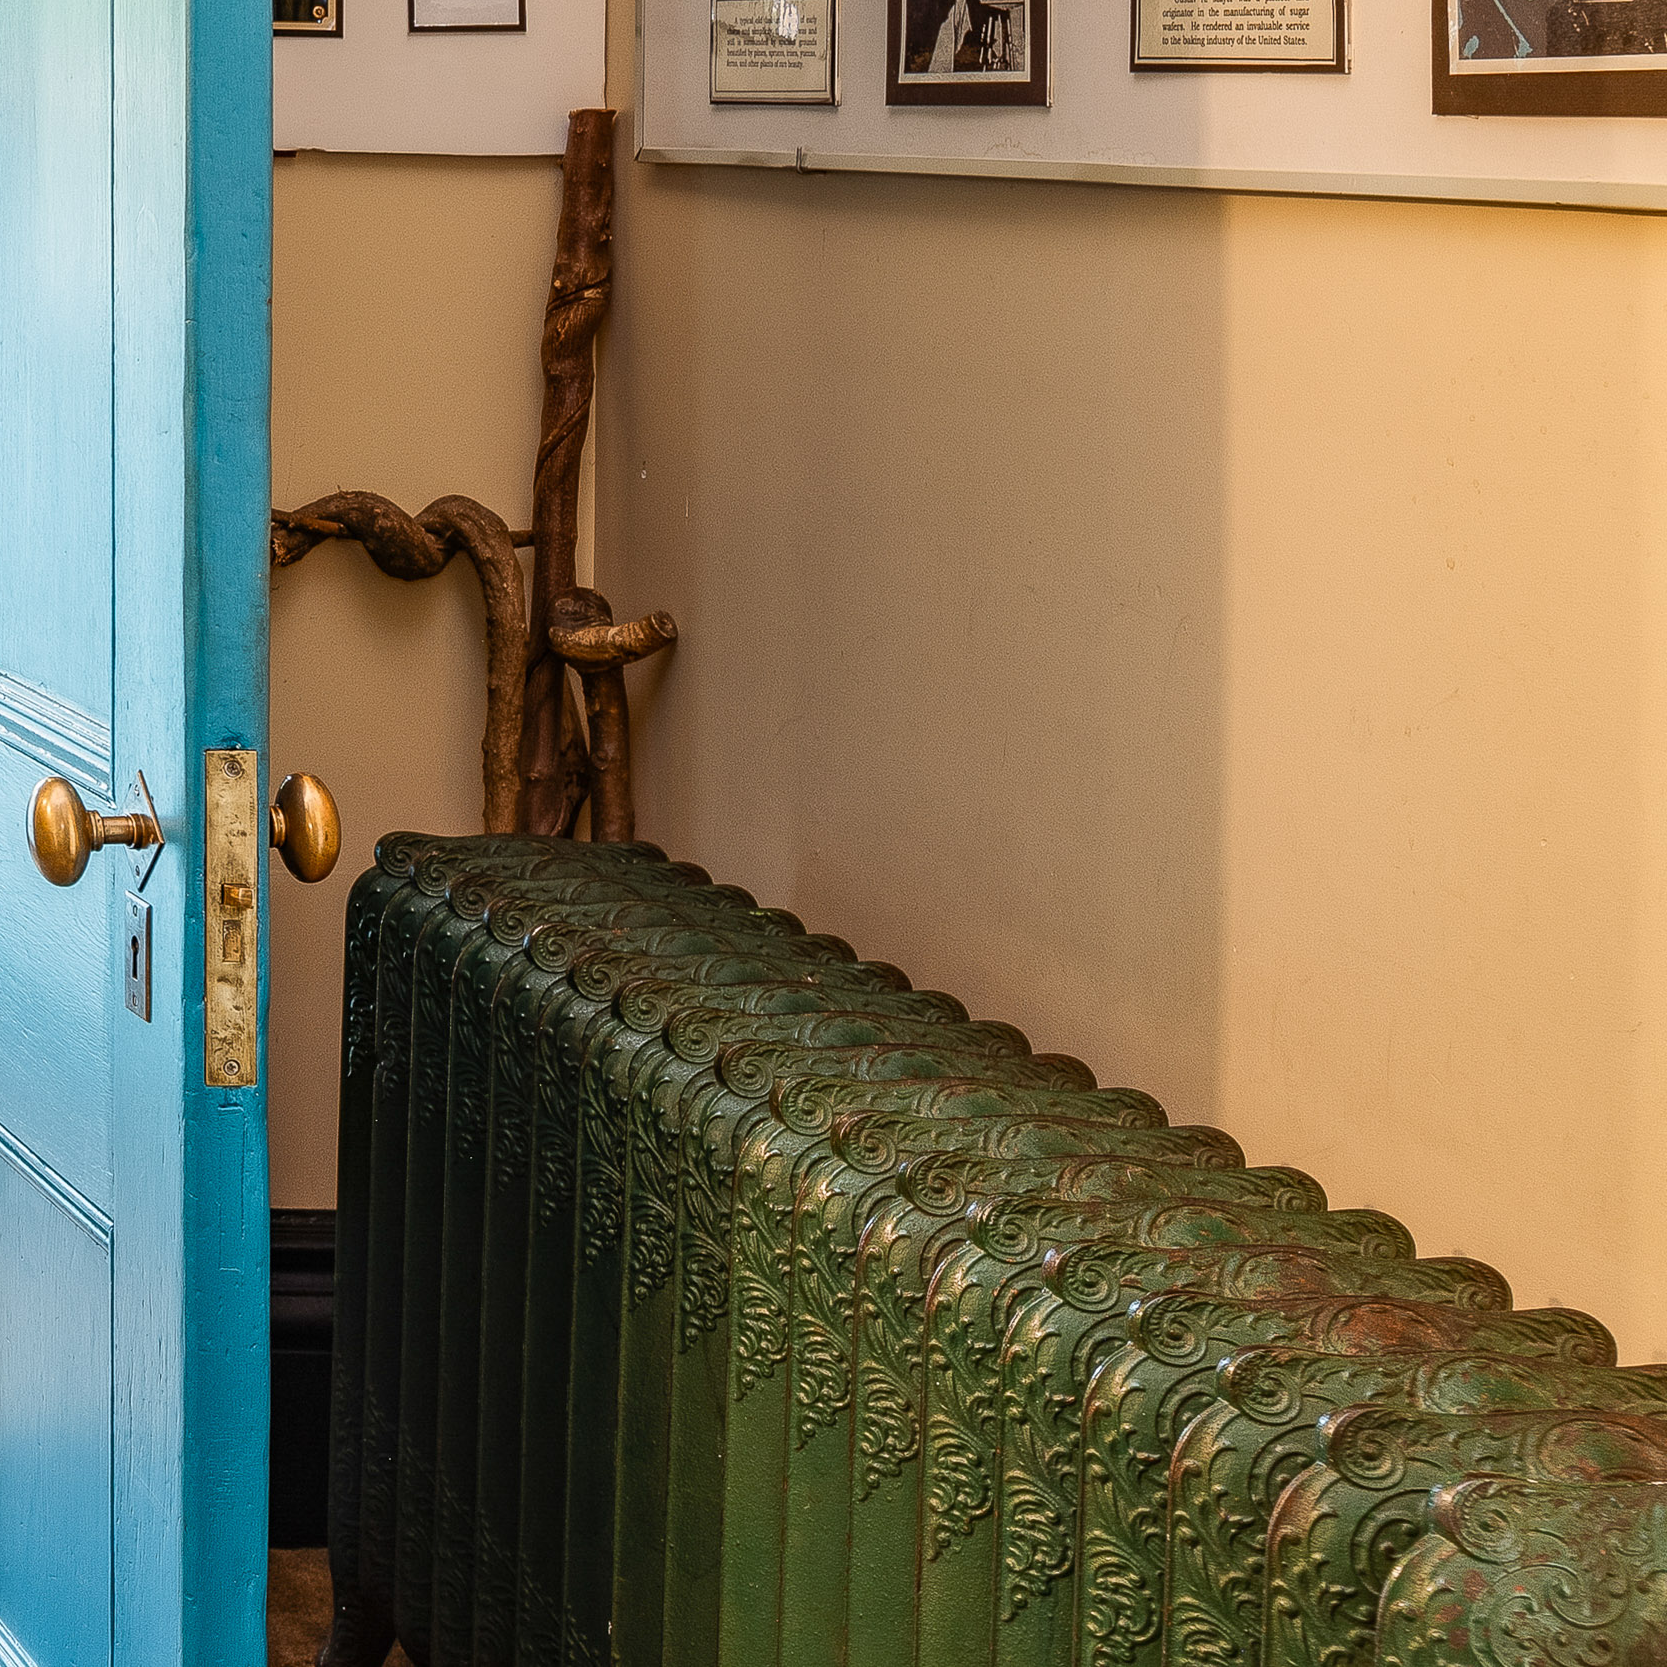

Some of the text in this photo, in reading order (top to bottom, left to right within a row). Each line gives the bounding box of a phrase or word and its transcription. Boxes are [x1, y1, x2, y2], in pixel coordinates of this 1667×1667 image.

[1162, 6, 1310, 20] originator in the manufacturing of sugar
[1162, 21, 1310, 31] wafers. He rendered an invaluable service
[1162, 34, 1308, 47] to the baking industry of the United States.
